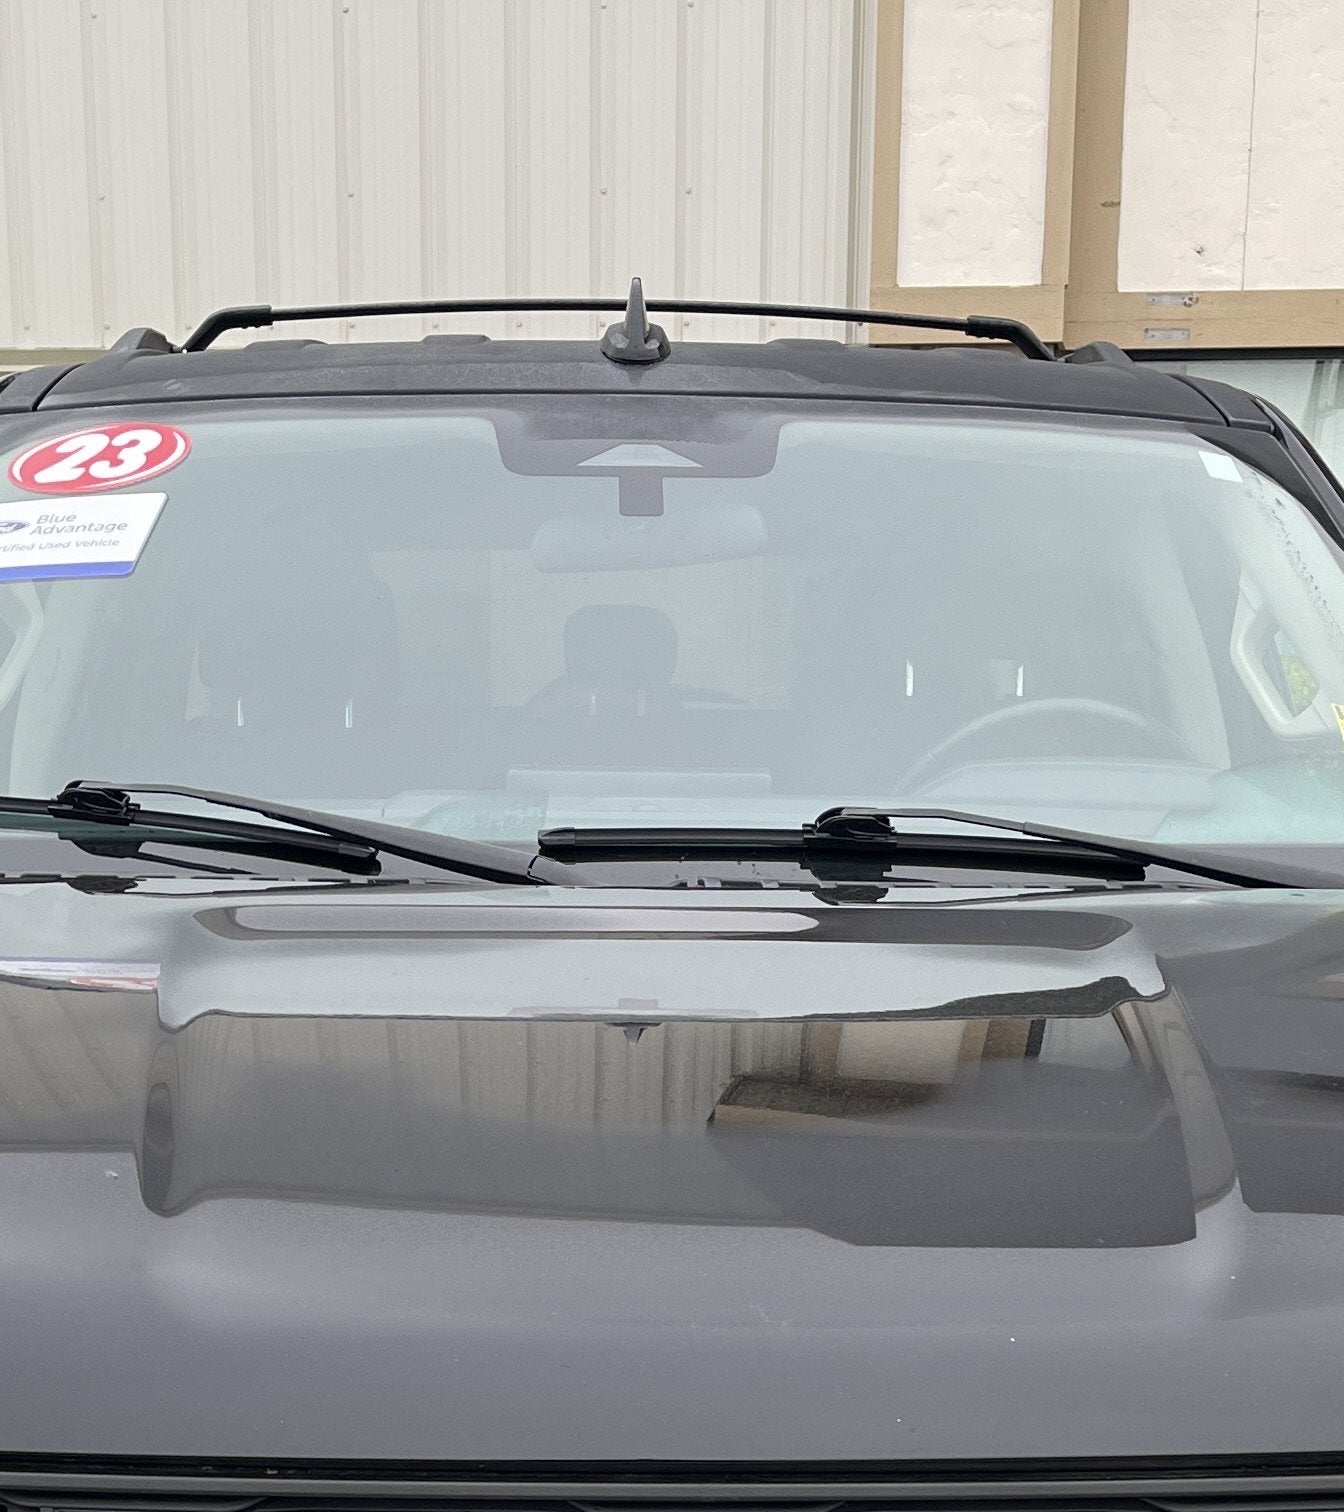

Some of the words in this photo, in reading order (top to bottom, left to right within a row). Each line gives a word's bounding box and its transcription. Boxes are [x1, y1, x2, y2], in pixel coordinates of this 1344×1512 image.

[34, 429, 163, 484] 23
[36, 513, 77, 524] Blue
[30, 521, 128, 535] Advantage
[39, 541, 70, 550] Used
[75, 538, 120, 548] Vehicle
